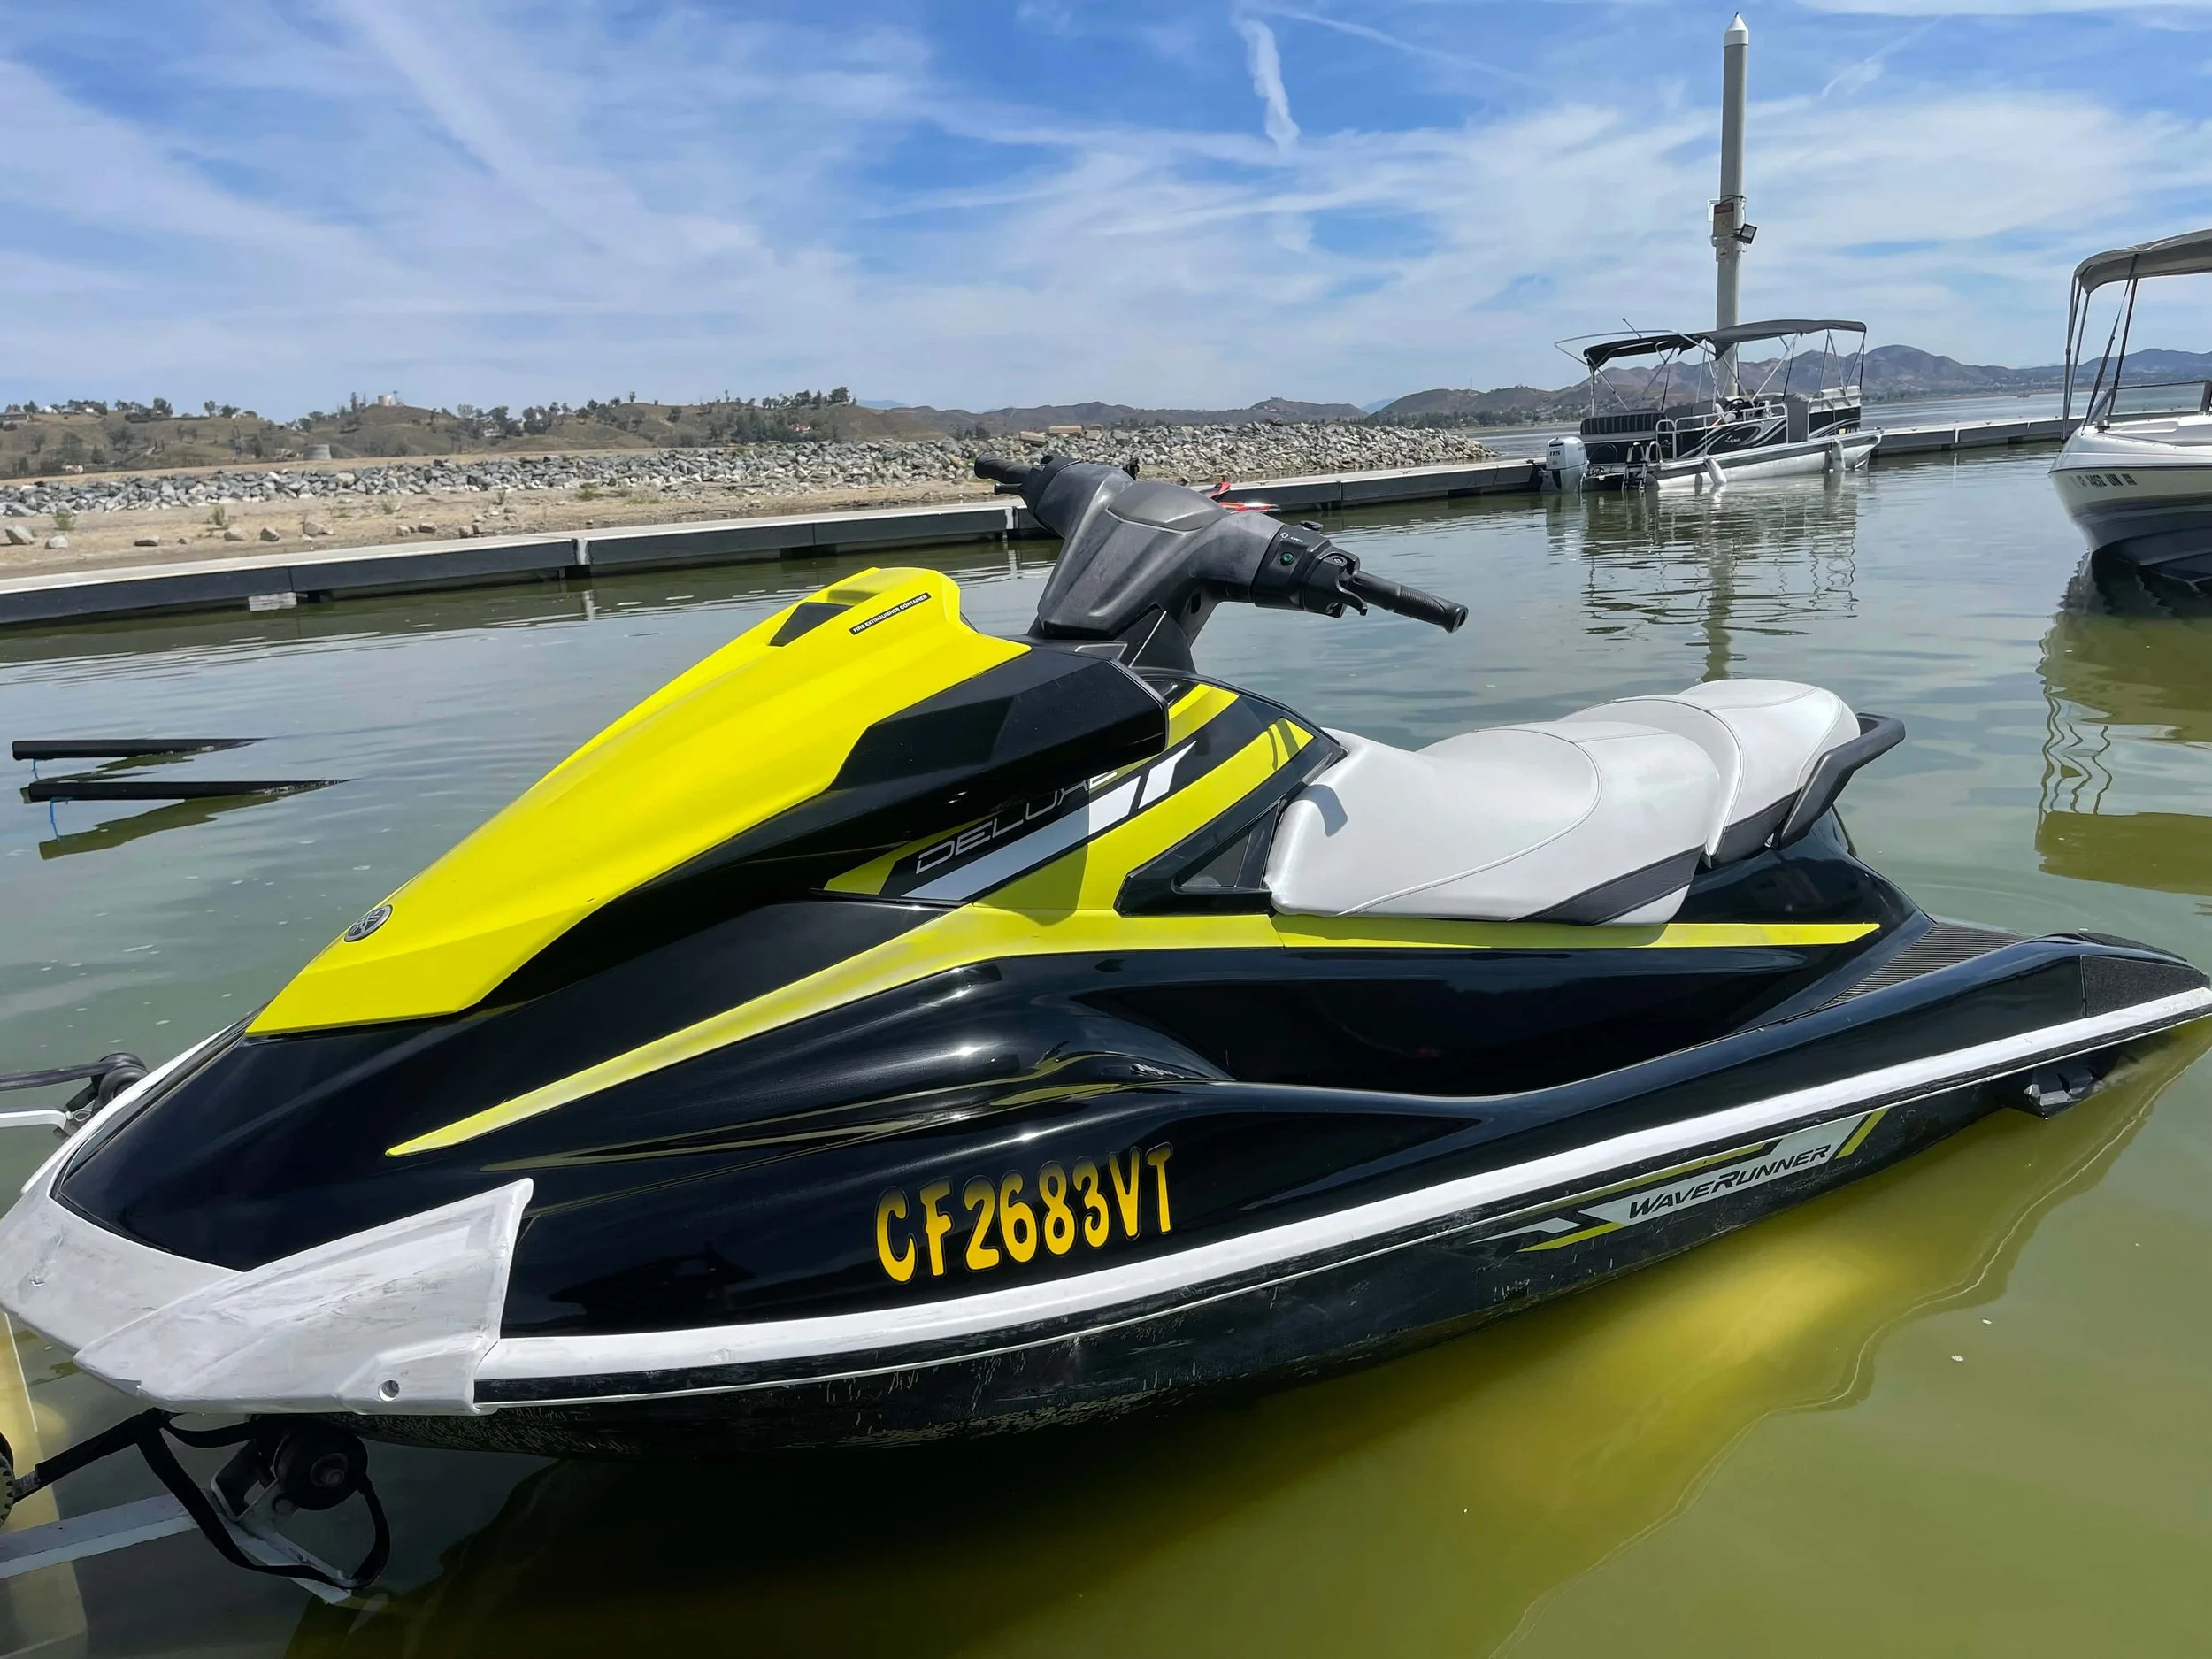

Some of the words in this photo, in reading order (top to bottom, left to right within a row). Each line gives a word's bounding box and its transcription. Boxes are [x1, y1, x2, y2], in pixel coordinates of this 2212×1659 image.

[852, 623, 866, 634] FIRE
[864, 606, 901, 627] EXTINGUISHER
[899, 594, 928, 611] CONTAINER
[874, 1141, 1174, 1285] CF2683VT
